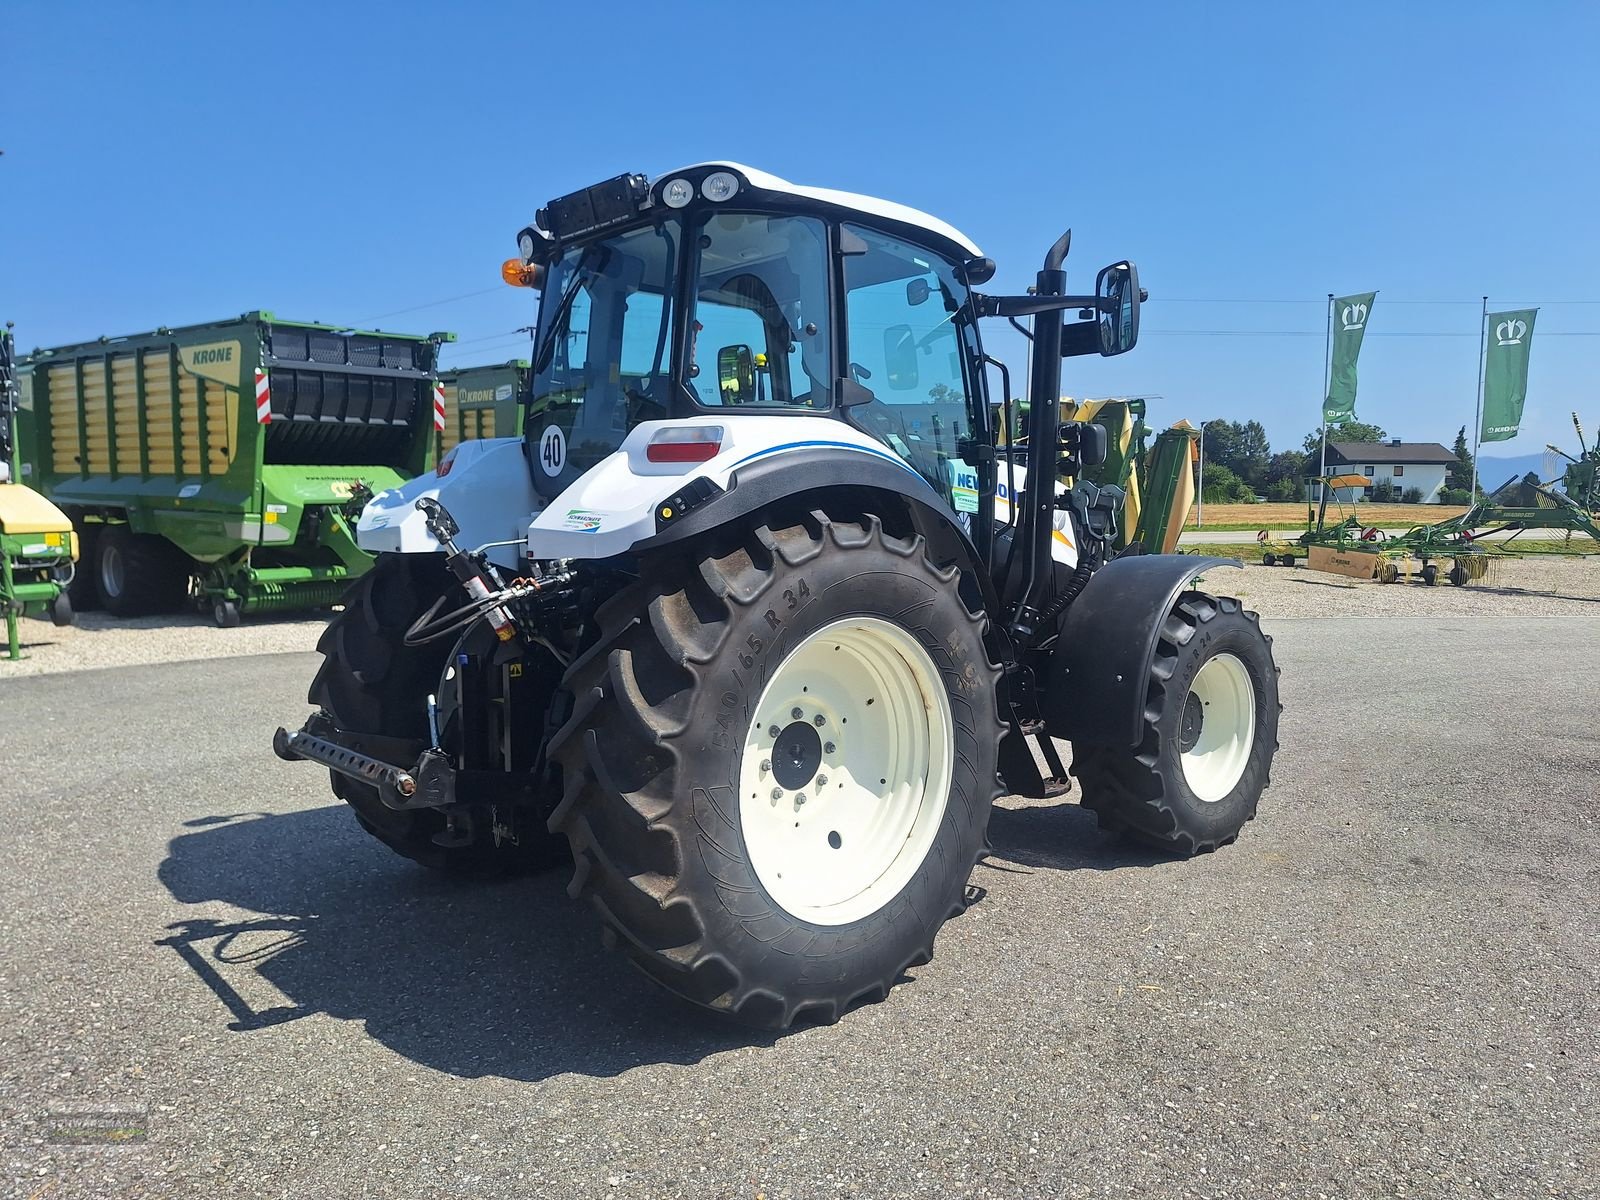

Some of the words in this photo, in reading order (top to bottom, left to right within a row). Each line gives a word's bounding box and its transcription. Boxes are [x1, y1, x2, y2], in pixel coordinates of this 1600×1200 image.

[192, 347, 233, 365] KRONE
[467, 389, 495, 402] KRONE
[543, 434, 561, 468] 40
[763, 609, 782, 632] R
[782, 577, 811, 609] 34
